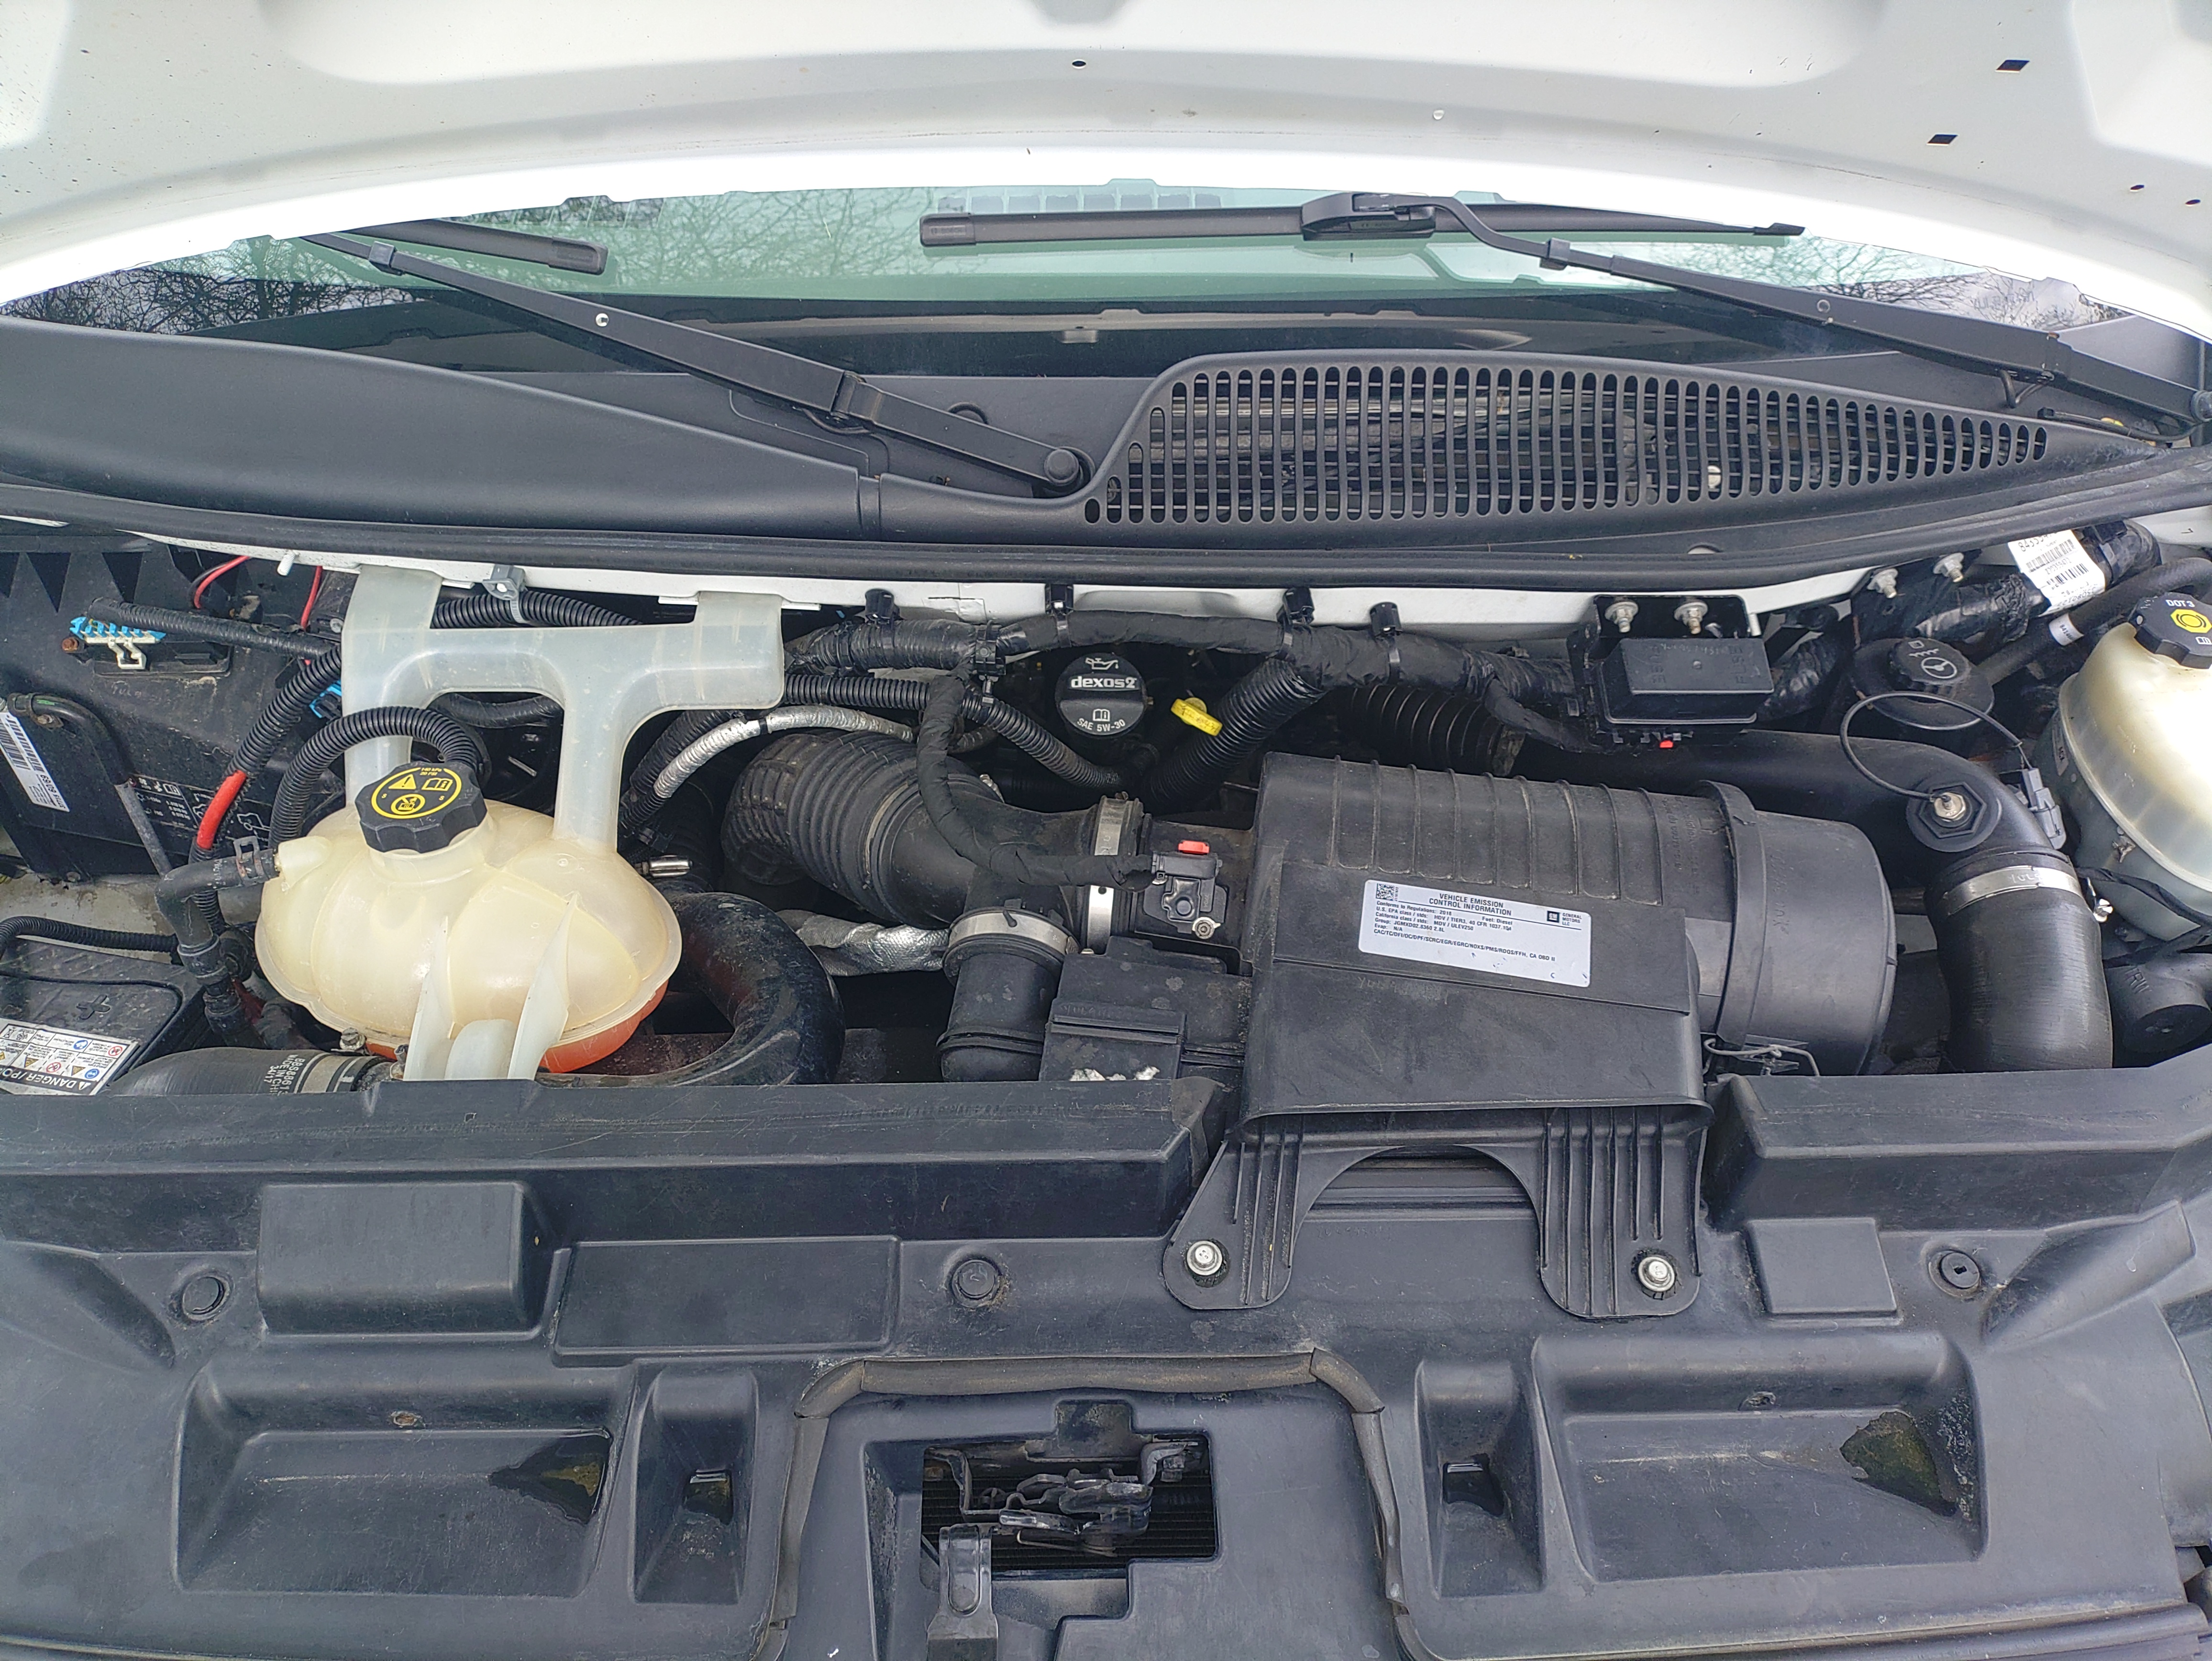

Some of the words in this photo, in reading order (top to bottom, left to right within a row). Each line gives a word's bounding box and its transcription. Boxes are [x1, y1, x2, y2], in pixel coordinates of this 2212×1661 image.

[1077, 718, 1094, 730] SAE
[1097, 719, 1125, 731] 5W-30
[1429, 897, 1461, 908] CONTROL
[1463, 903, 1512, 916] INFORMATION
[1439, 893, 1468, 903] VEHICLE
[1470, 897, 1504, 908] EMISSION
[1375, 911, 1398, 919] California
[1407, 905, 1437, 914] Regulations:
[279, 1054, 299, 1069] MADE
[26, 1073, 77, 1089] DANGER
